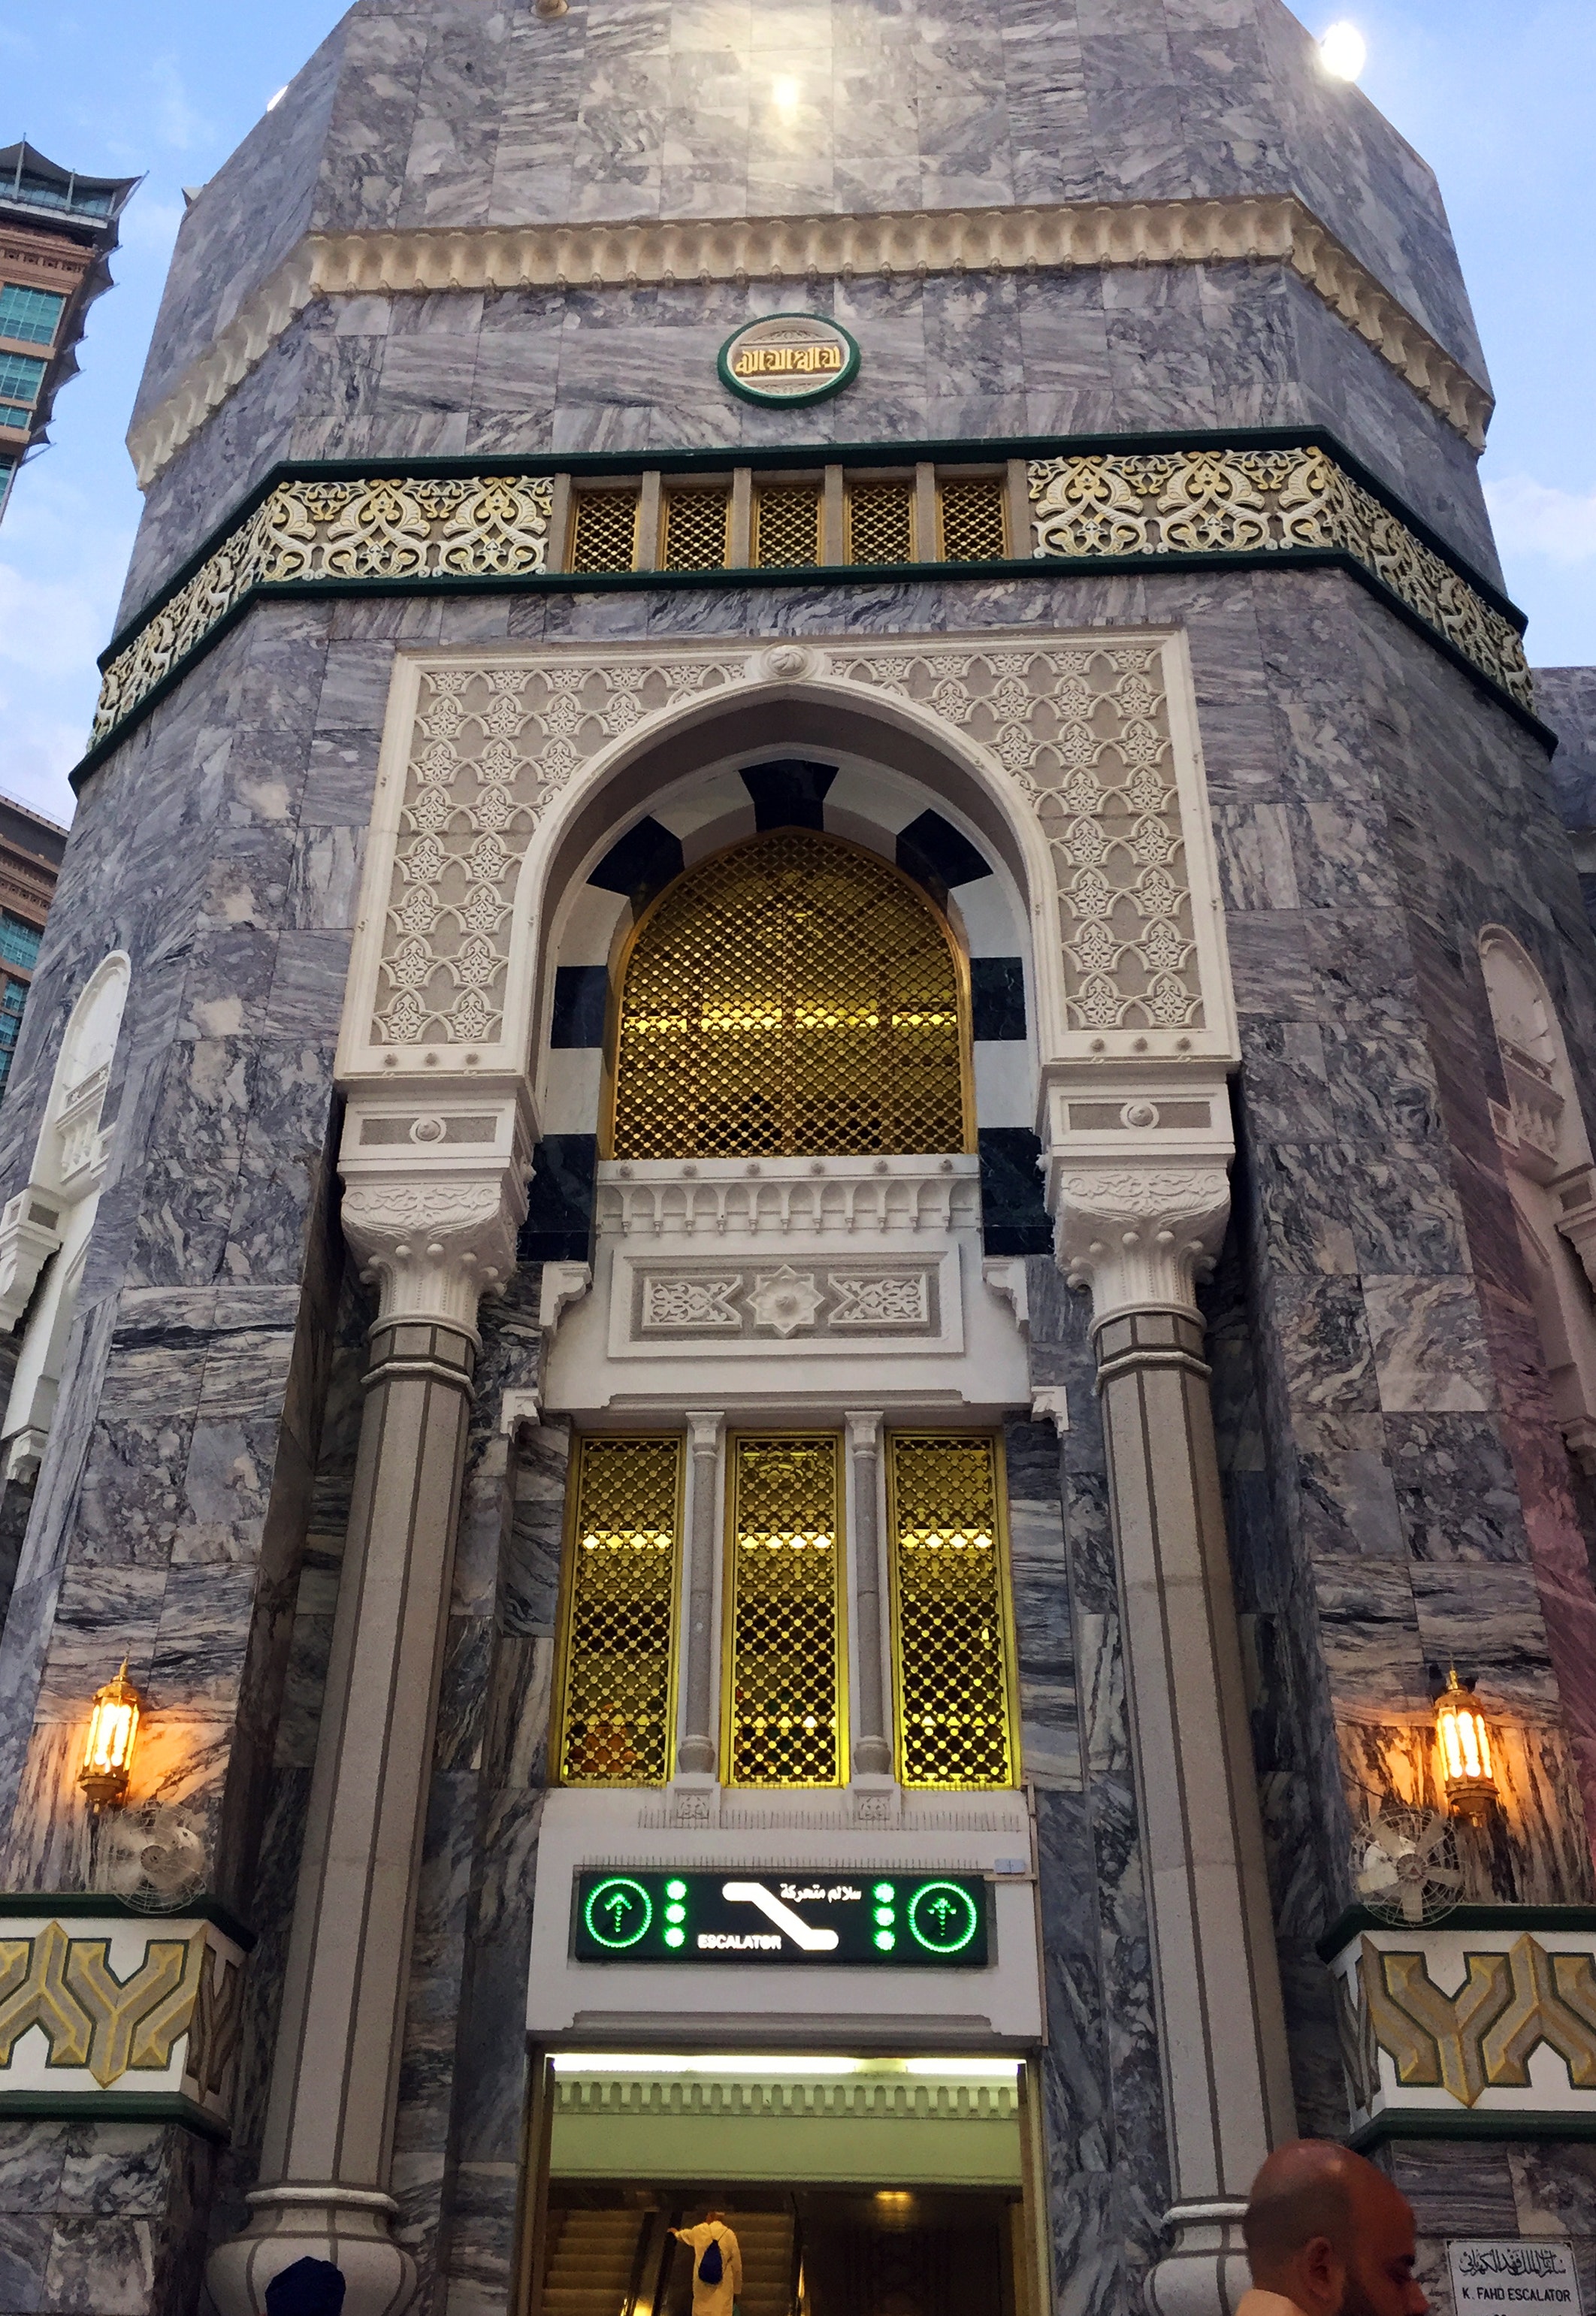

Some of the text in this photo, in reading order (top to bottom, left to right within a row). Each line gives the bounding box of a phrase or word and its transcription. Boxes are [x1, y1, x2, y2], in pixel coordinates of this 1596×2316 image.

[779, 1883, 862, 1903] سلالم متحركة
[697, 1934, 781, 1949] ESCALATOR
[1462, 2287, 1571, 2302] K. FAHD ESCALATOR
